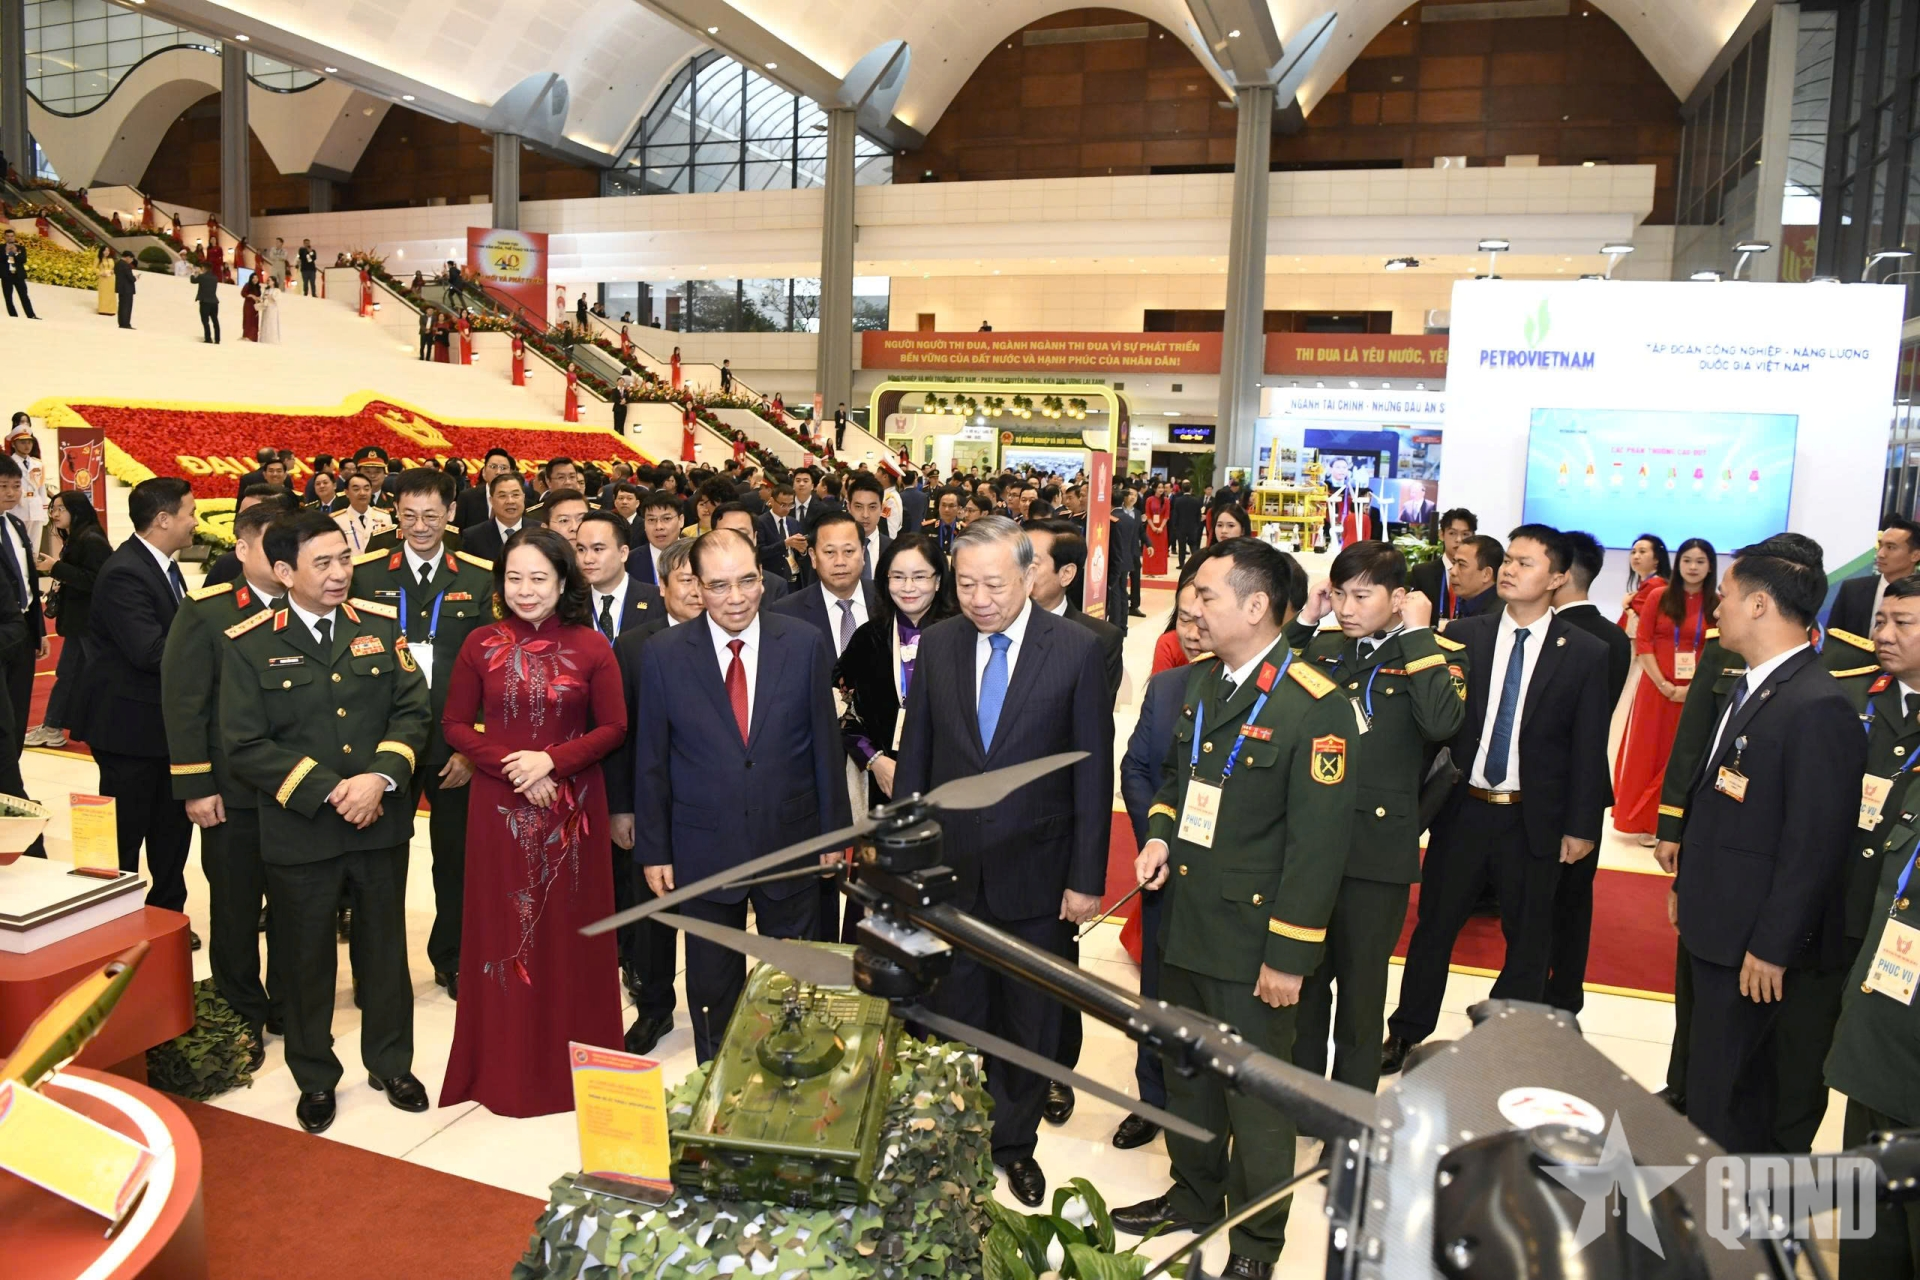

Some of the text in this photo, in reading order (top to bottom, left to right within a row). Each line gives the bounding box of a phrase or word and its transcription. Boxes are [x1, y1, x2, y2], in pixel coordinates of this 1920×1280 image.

[494, 254, 520, 270] 40
[884, 339, 1200, 353] NGƯỜI NGƯỜI THI ĐUA, NGÀNH NGÀNH THI ĐUA VÌ SỰ PHÁT TRIỂN
[949, 352, 970, 364] CỦA
[972, 353, 990, 364] ĐẤT
[992, 354, 1020, 364] NƯỚC
[1023, 353, 1035, 364] VÀ
[1037, 355, 1066, 366] HẠNH
[1068, 354, 1097, 365] PHÚC
[1099, 354, 1120, 365] CỦA
[1122, 355, 1152, 366] NHÂN
[1154, 355, 1181, 366] DÂN!
[1295, 347, 1314, 361] THI
[1317, 348, 1341, 362] ĐUA
[1344, 346, 1358, 362] LÀ
[1362, 346, 1385, 363] YÊU
[1388, 348, 1425, 365] NƯỚC,
[1480, 349, 1596, 368] PETROVIETNAM
[1733, 361, 1751, 370] GIA
[1784, 361, 1810, 372] NAM
[1439, 403, 1445, 414] S
[175, 455, 251, 480] ĐẠI
[1877, 958, 1914, 985] PHỤC VỤ
